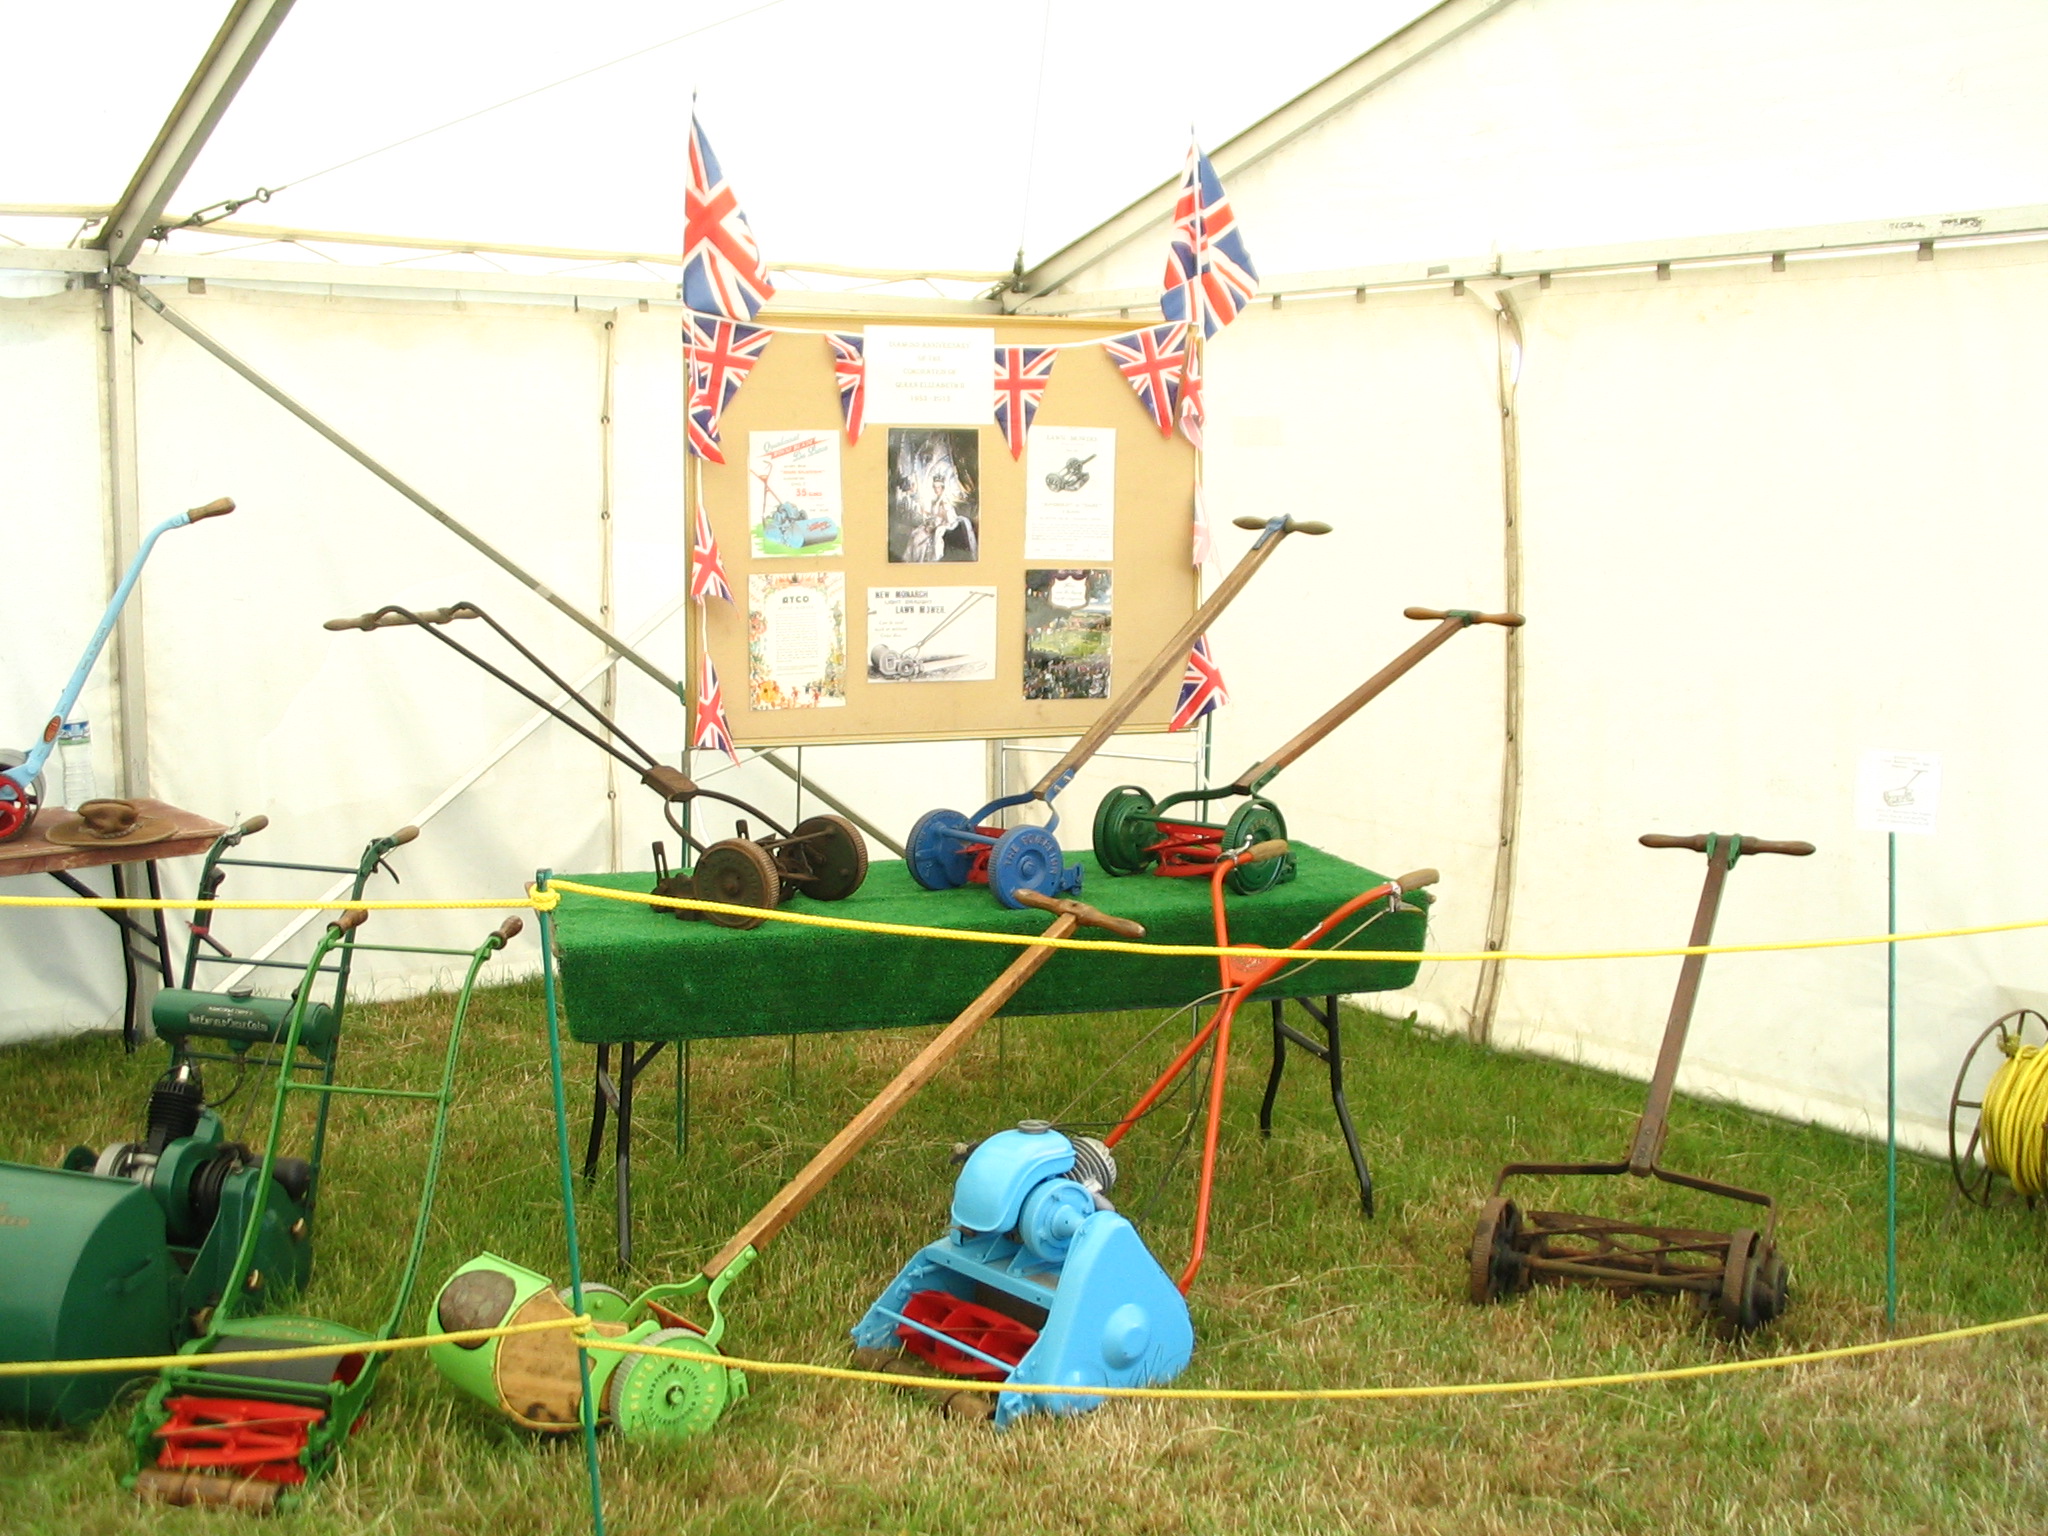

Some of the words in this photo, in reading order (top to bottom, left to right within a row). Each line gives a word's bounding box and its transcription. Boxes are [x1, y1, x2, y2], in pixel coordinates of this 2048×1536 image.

[875, 591, 890, 599] NEW
[895, 590, 928, 599] MONARCH
[782, 595, 810, 604] ATCO
[895, 606, 915, 614] LAWN
